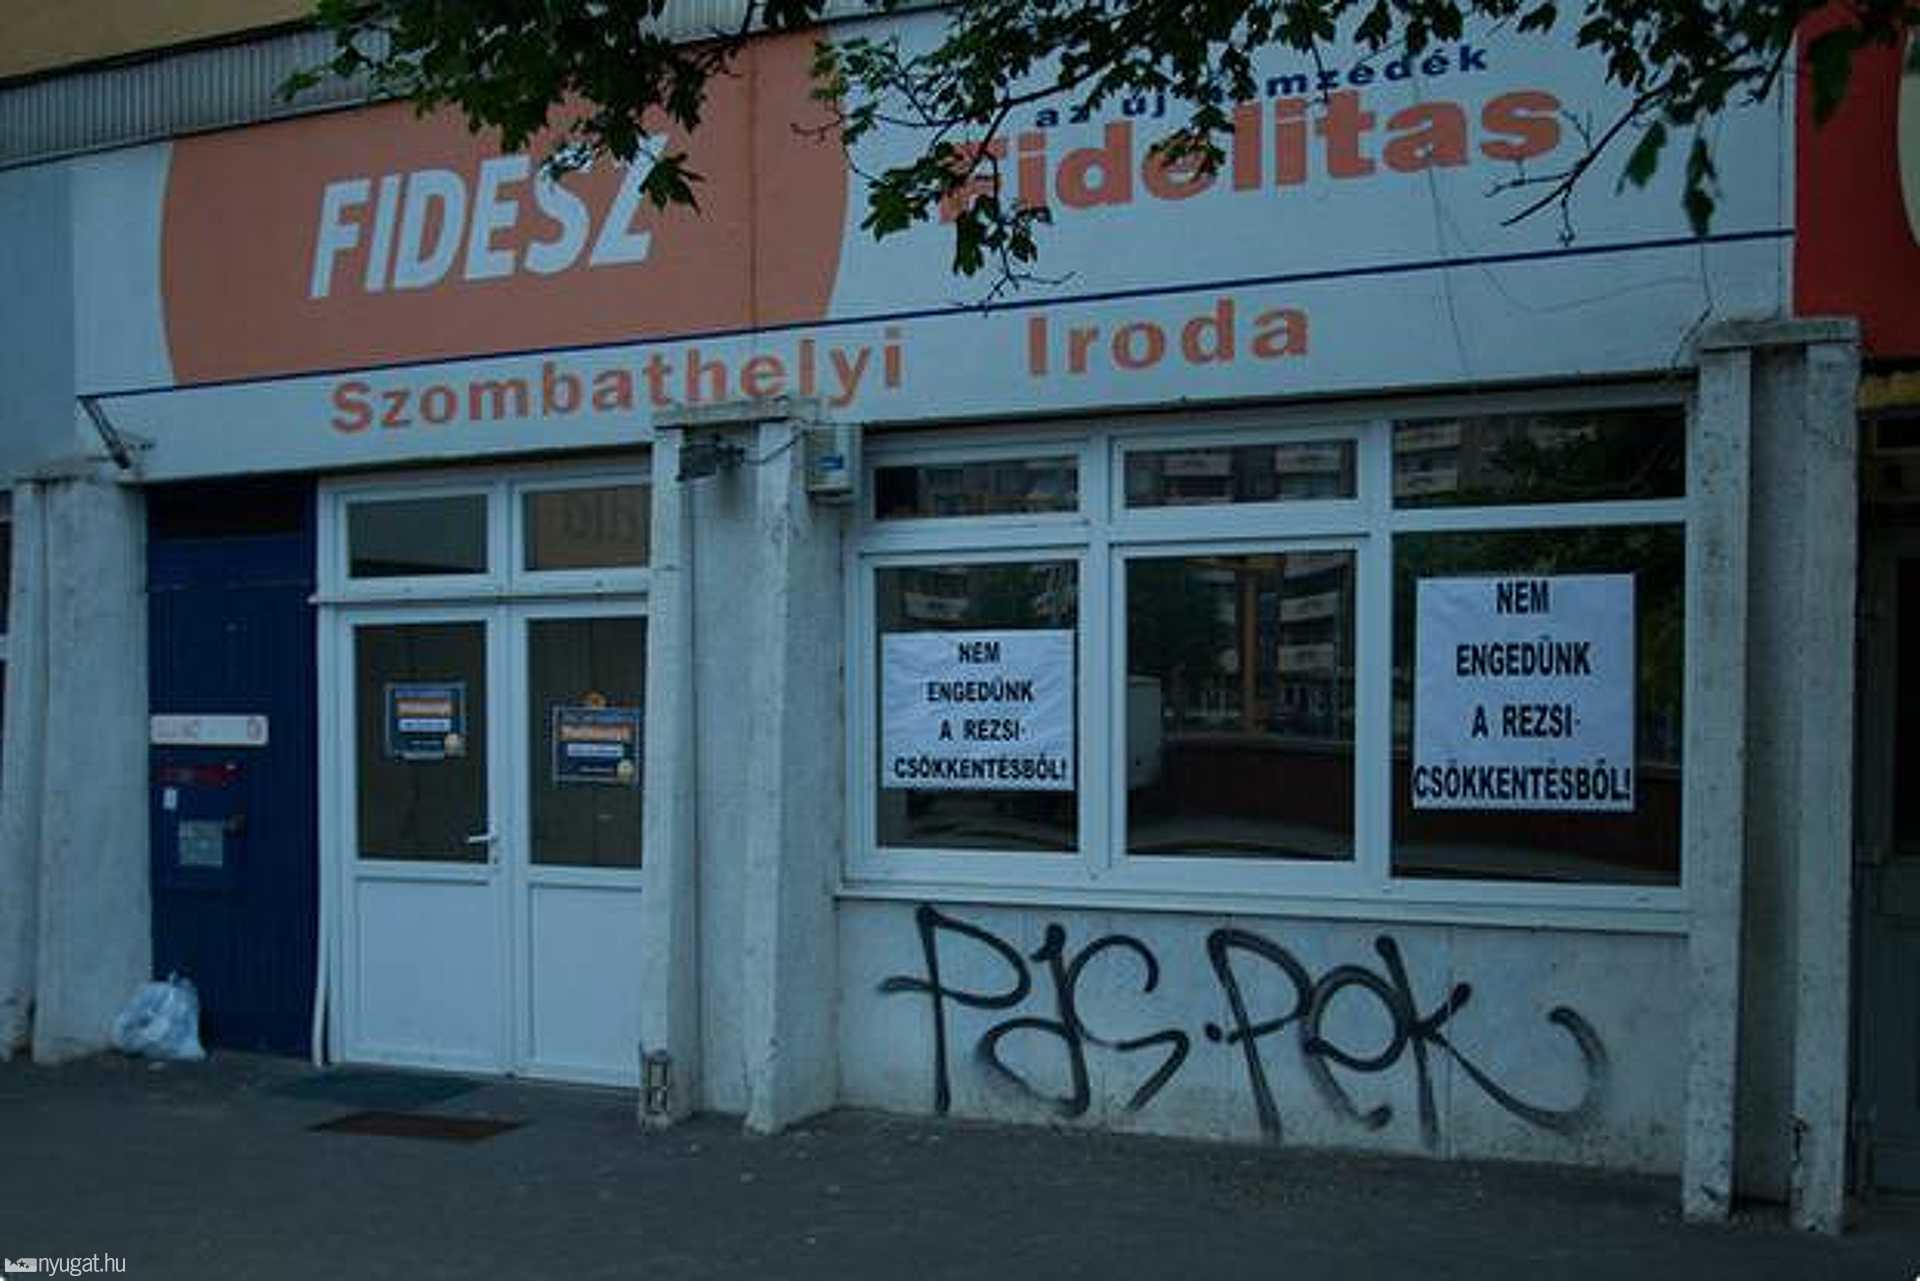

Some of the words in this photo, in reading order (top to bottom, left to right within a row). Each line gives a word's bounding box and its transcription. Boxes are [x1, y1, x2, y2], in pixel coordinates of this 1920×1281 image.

[309, 132, 670, 300] FIDESZ
[331, 328, 901, 432] Szombathelyi
[1028, 298, 1309, 377] Iroda
[1496, 580, 1550, 615] NEM
[957, 641, 1001, 664] NEM
[1455, 635, 1592, 677] ENGEDÜNK
[938, 719, 954, 741] A
[1471, 703, 1489, 738] A
